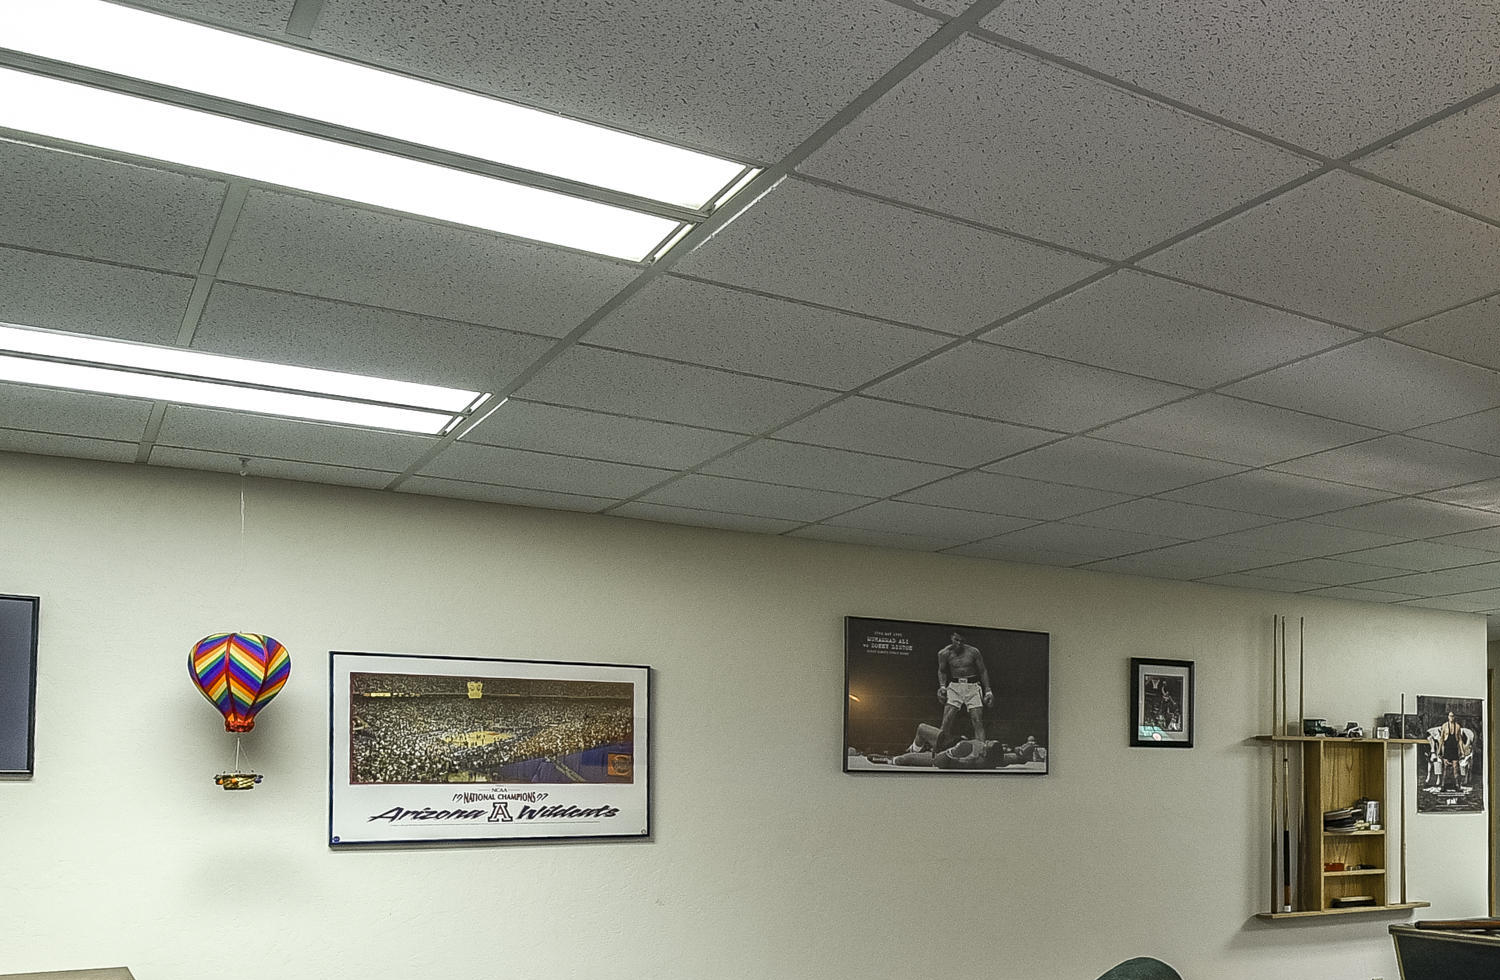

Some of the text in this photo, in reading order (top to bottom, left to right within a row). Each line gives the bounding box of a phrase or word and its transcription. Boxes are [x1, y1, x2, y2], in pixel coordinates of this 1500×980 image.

[463, 792, 495, 804] NATIONAL
[497, 792, 536, 803] CHAMPIONS
[368, 801, 621, 823] Arizona A Wildcats
